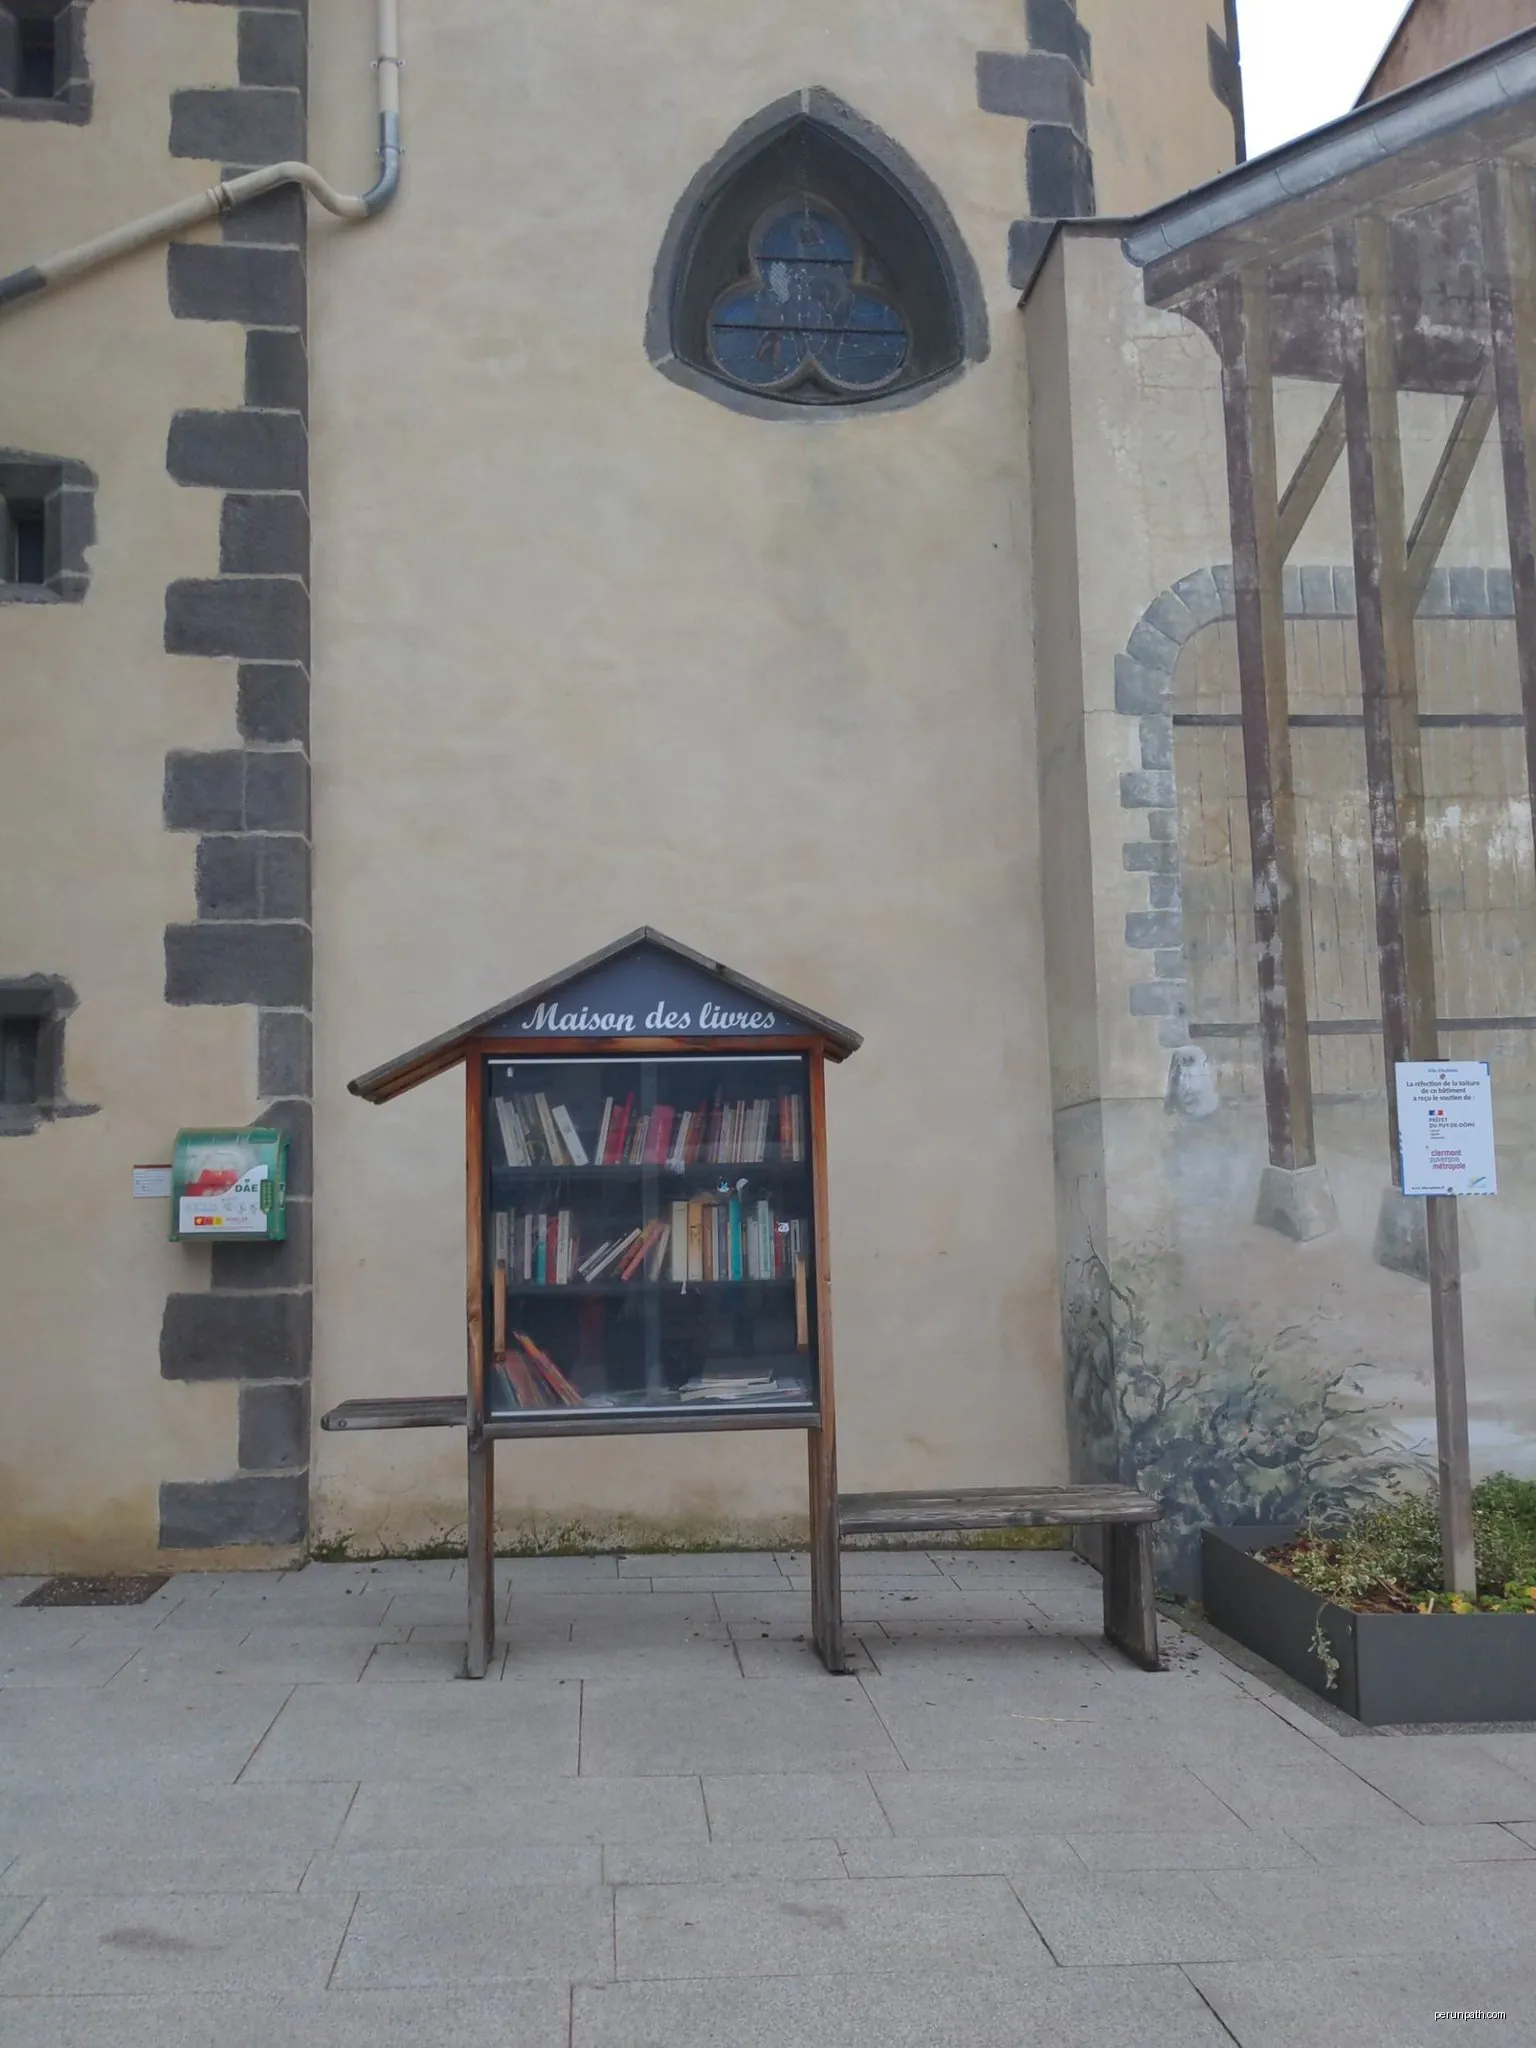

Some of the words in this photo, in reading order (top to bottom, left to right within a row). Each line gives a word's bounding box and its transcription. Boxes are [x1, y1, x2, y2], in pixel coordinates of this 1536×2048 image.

[522, 1002, 636, 1031] Maison
[645, 1001, 690, 1029] des
[699, 1002, 775, 1029] livres
[1432, 1162, 1466, 1170] métropole
[235, 1184, 258, 1192] DAE
